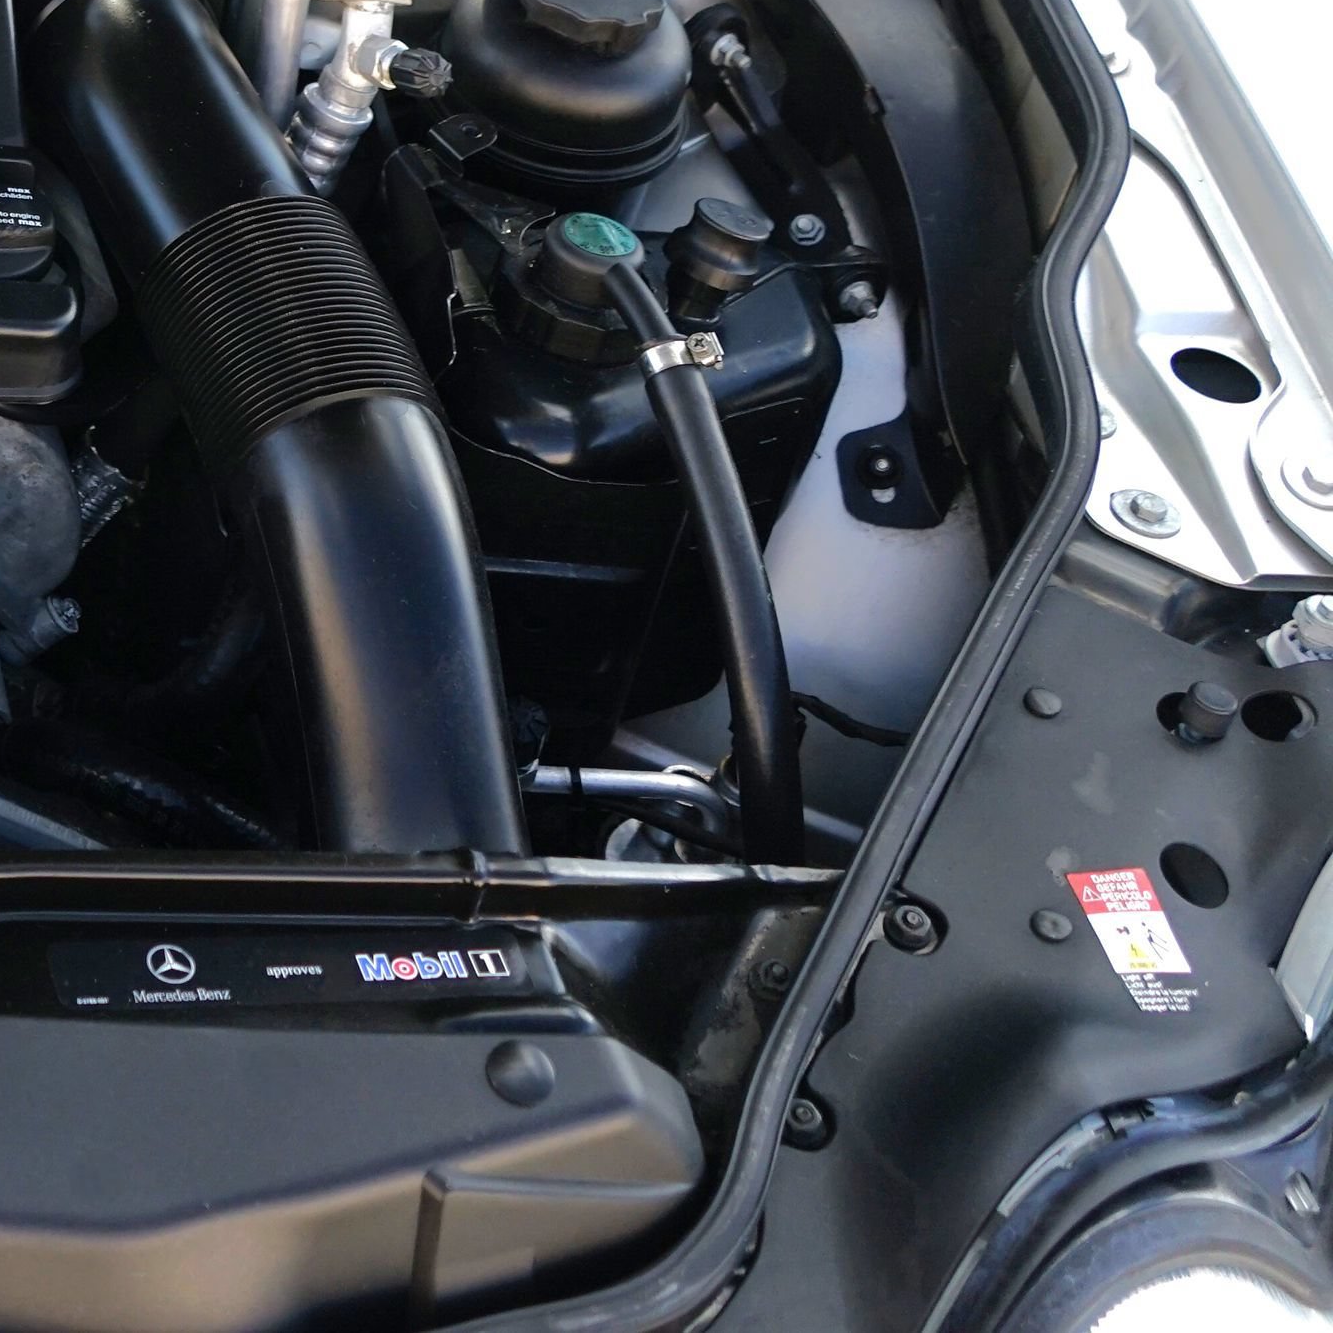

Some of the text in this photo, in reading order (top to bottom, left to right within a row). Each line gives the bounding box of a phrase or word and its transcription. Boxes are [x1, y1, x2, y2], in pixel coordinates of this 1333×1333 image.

[9, 212, 40, 220] engine
[18, 219, 43, 227] max
[1090, 871, 1136, 883] DANGER
[1096, 881, 1138, 893] GEFAHR
[1100, 890, 1152, 902] PERICOLO
[1105, 900, 1151, 912] PELIGRO
[266, 964, 322, 978] approves
[355, 951, 468, 982] Mobil
[132, 987, 231, 1004] Mercedes-Benz
